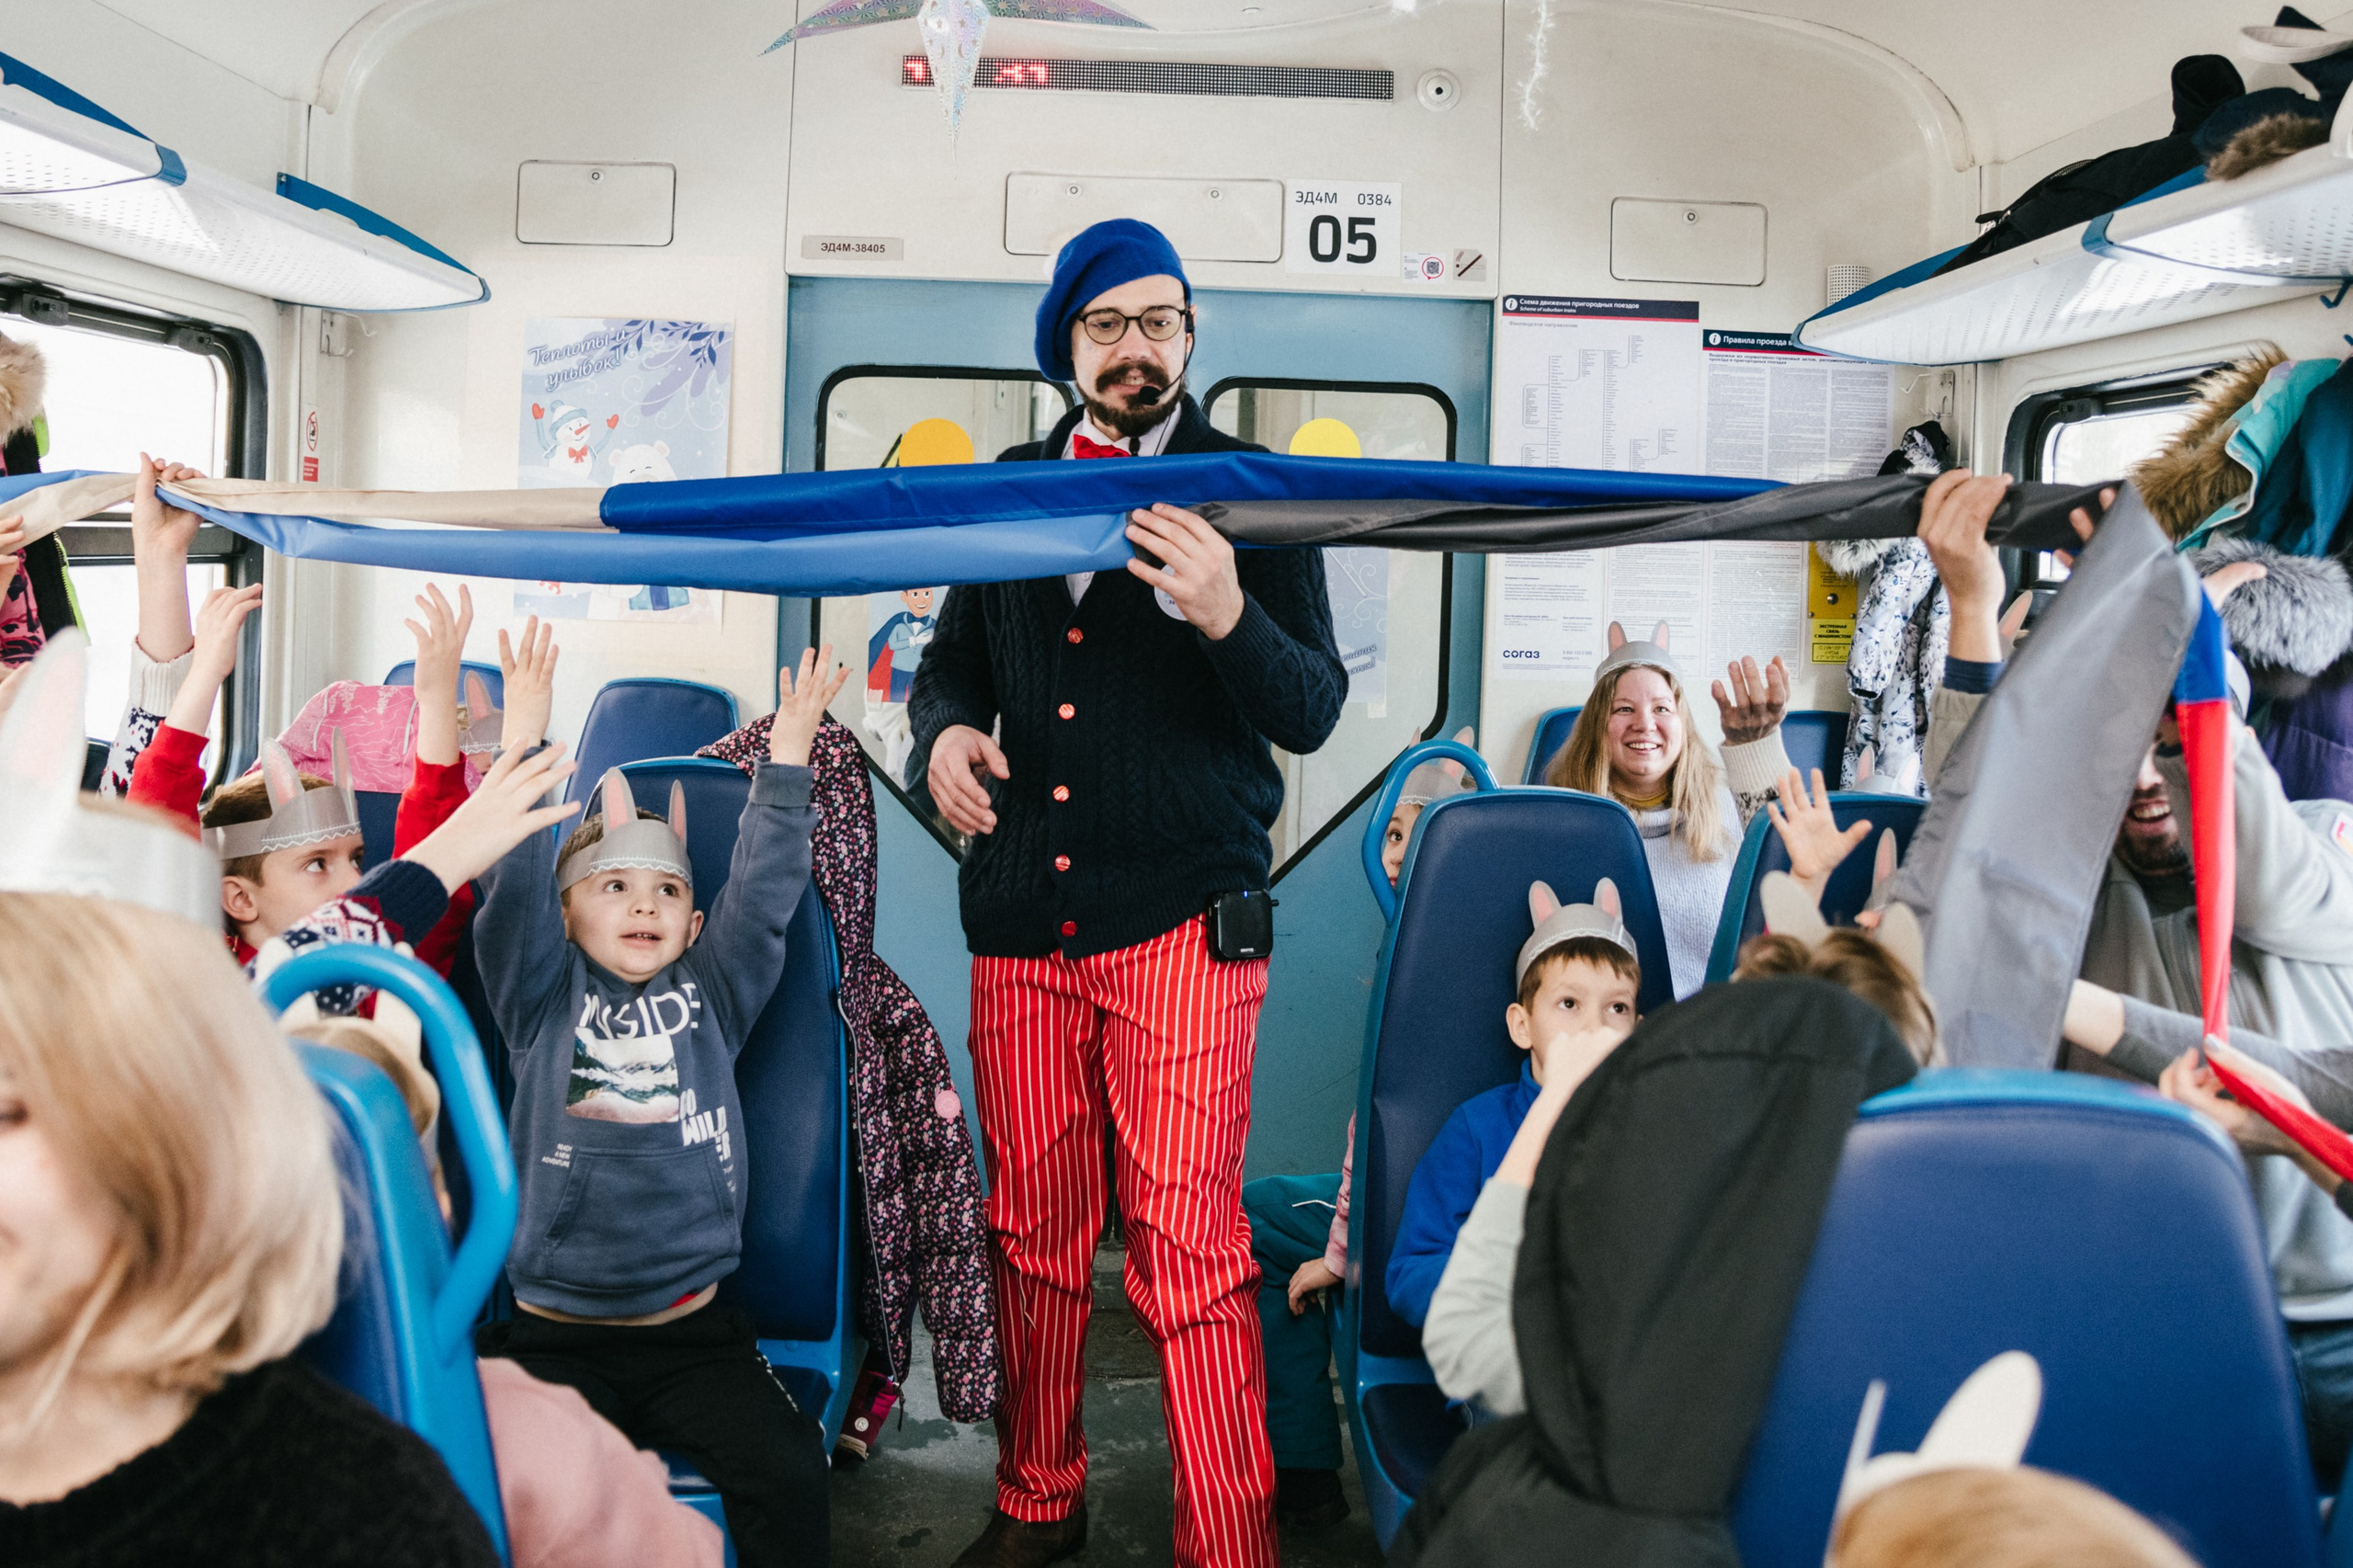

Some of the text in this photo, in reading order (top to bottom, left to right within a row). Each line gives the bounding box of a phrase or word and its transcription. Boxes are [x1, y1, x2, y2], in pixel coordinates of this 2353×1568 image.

[1295, 190, 1392, 206] ЭД4М 0384
[820, 242, 886, 254] ЭД4М-38405
[1309, 214, 1377, 264] 05
[529, 329, 627, 367] Теплоты и
[1723, 335, 1756, 345] Правила
[1756, 338, 1788, 347] проезда
[547, 347, 621, 392] улыбок!
[1503, 650, 1540, 659] согаз
[681, 1106, 727, 1147] WILD
